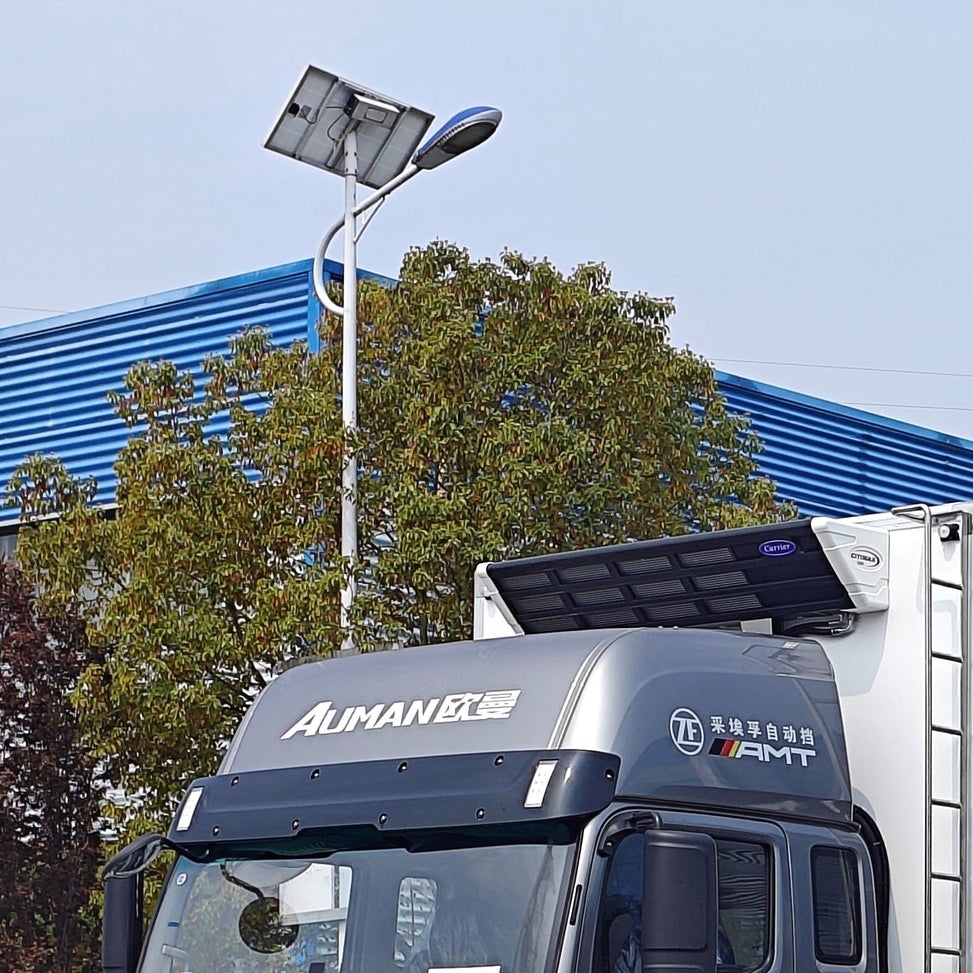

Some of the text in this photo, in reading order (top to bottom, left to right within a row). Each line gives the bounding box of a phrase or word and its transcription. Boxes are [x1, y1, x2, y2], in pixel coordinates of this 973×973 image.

[763, 543, 791, 553] Carrier
[672, 715, 702, 747] ZF
[711, 716, 815, 746] 采埃孚自动挡
[735, 741, 817, 767] AMT
